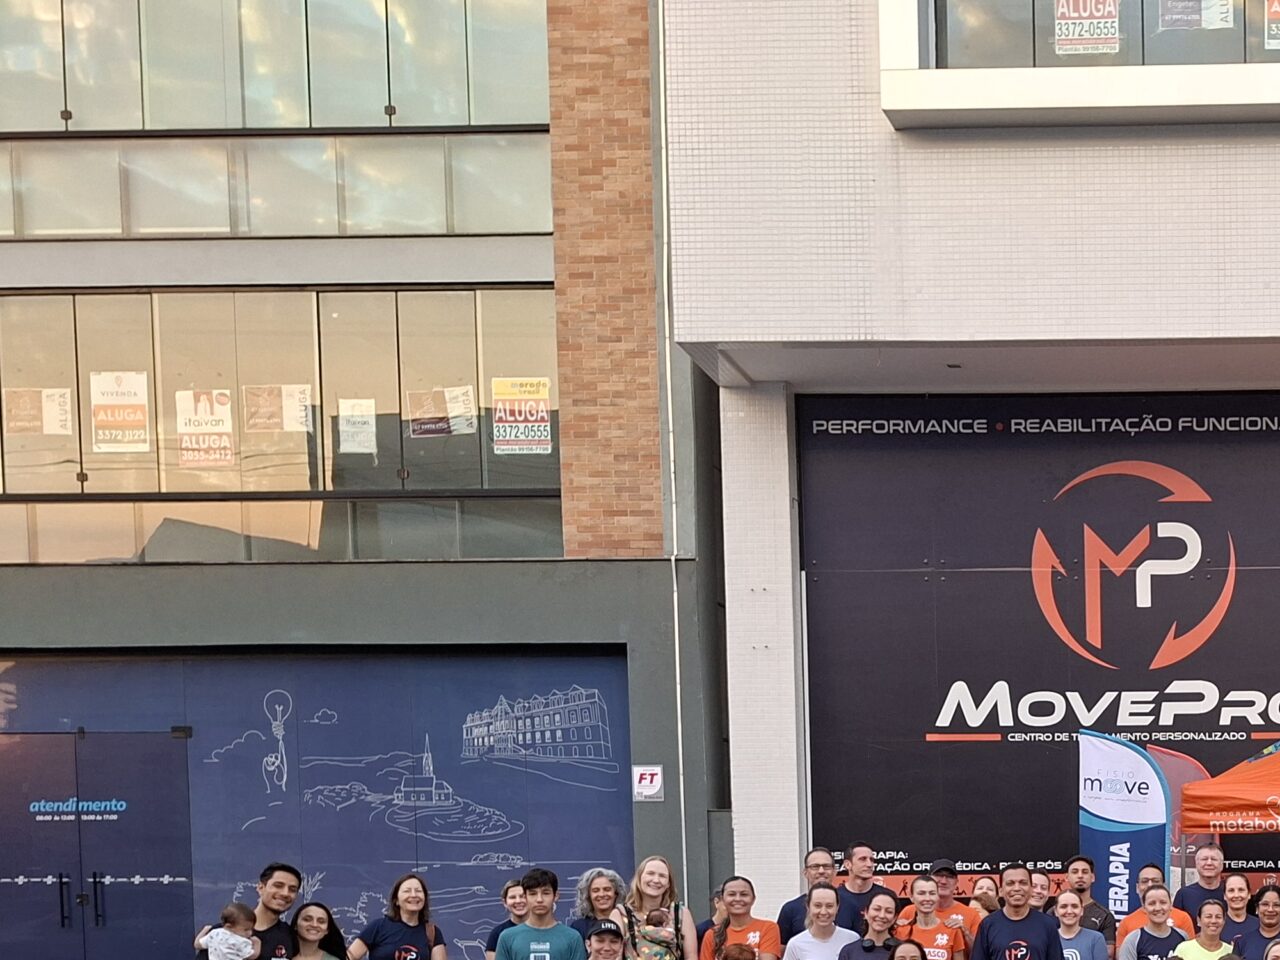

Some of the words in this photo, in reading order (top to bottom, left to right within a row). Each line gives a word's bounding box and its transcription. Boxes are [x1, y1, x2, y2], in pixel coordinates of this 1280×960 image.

[1057, 0, 1116, 17] ALUGA
[1056, 21, 1117, 38] 3372-0555
[100, 390, 138, 398] VIVENDA
[58, 392, 69, 431] ALUGA
[97, 408, 144, 421] ALUGA
[298, 388, 308, 428] ALUGA
[461, 390, 474, 429] ALUGA
[495, 400, 548, 421] ALUGA
[184, 417, 224, 427] itaivan
[812, 420, 988, 435] PERFORMANCE
[1010, 414, 1172, 437] REABILITAÇÃO
[97, 430, 122, 440] 3372
[494, 424, 550, 439] 3372-0555
[181, 435, 231, 449] ALUGA
[1007, 732, 1051, 742] CENTRO
[1054, 732, 1070, 741] DE
[1151, 732, 1247, 741] PERSONALIZADO
[638, 772, 659, 785] FT
[1096, 768, 1135, 779] FISIO
[29, 797, 127, 812] atendimento
[1026, 862, 1034, 870] E
[1036, 860, 1062, 869] PÓS
